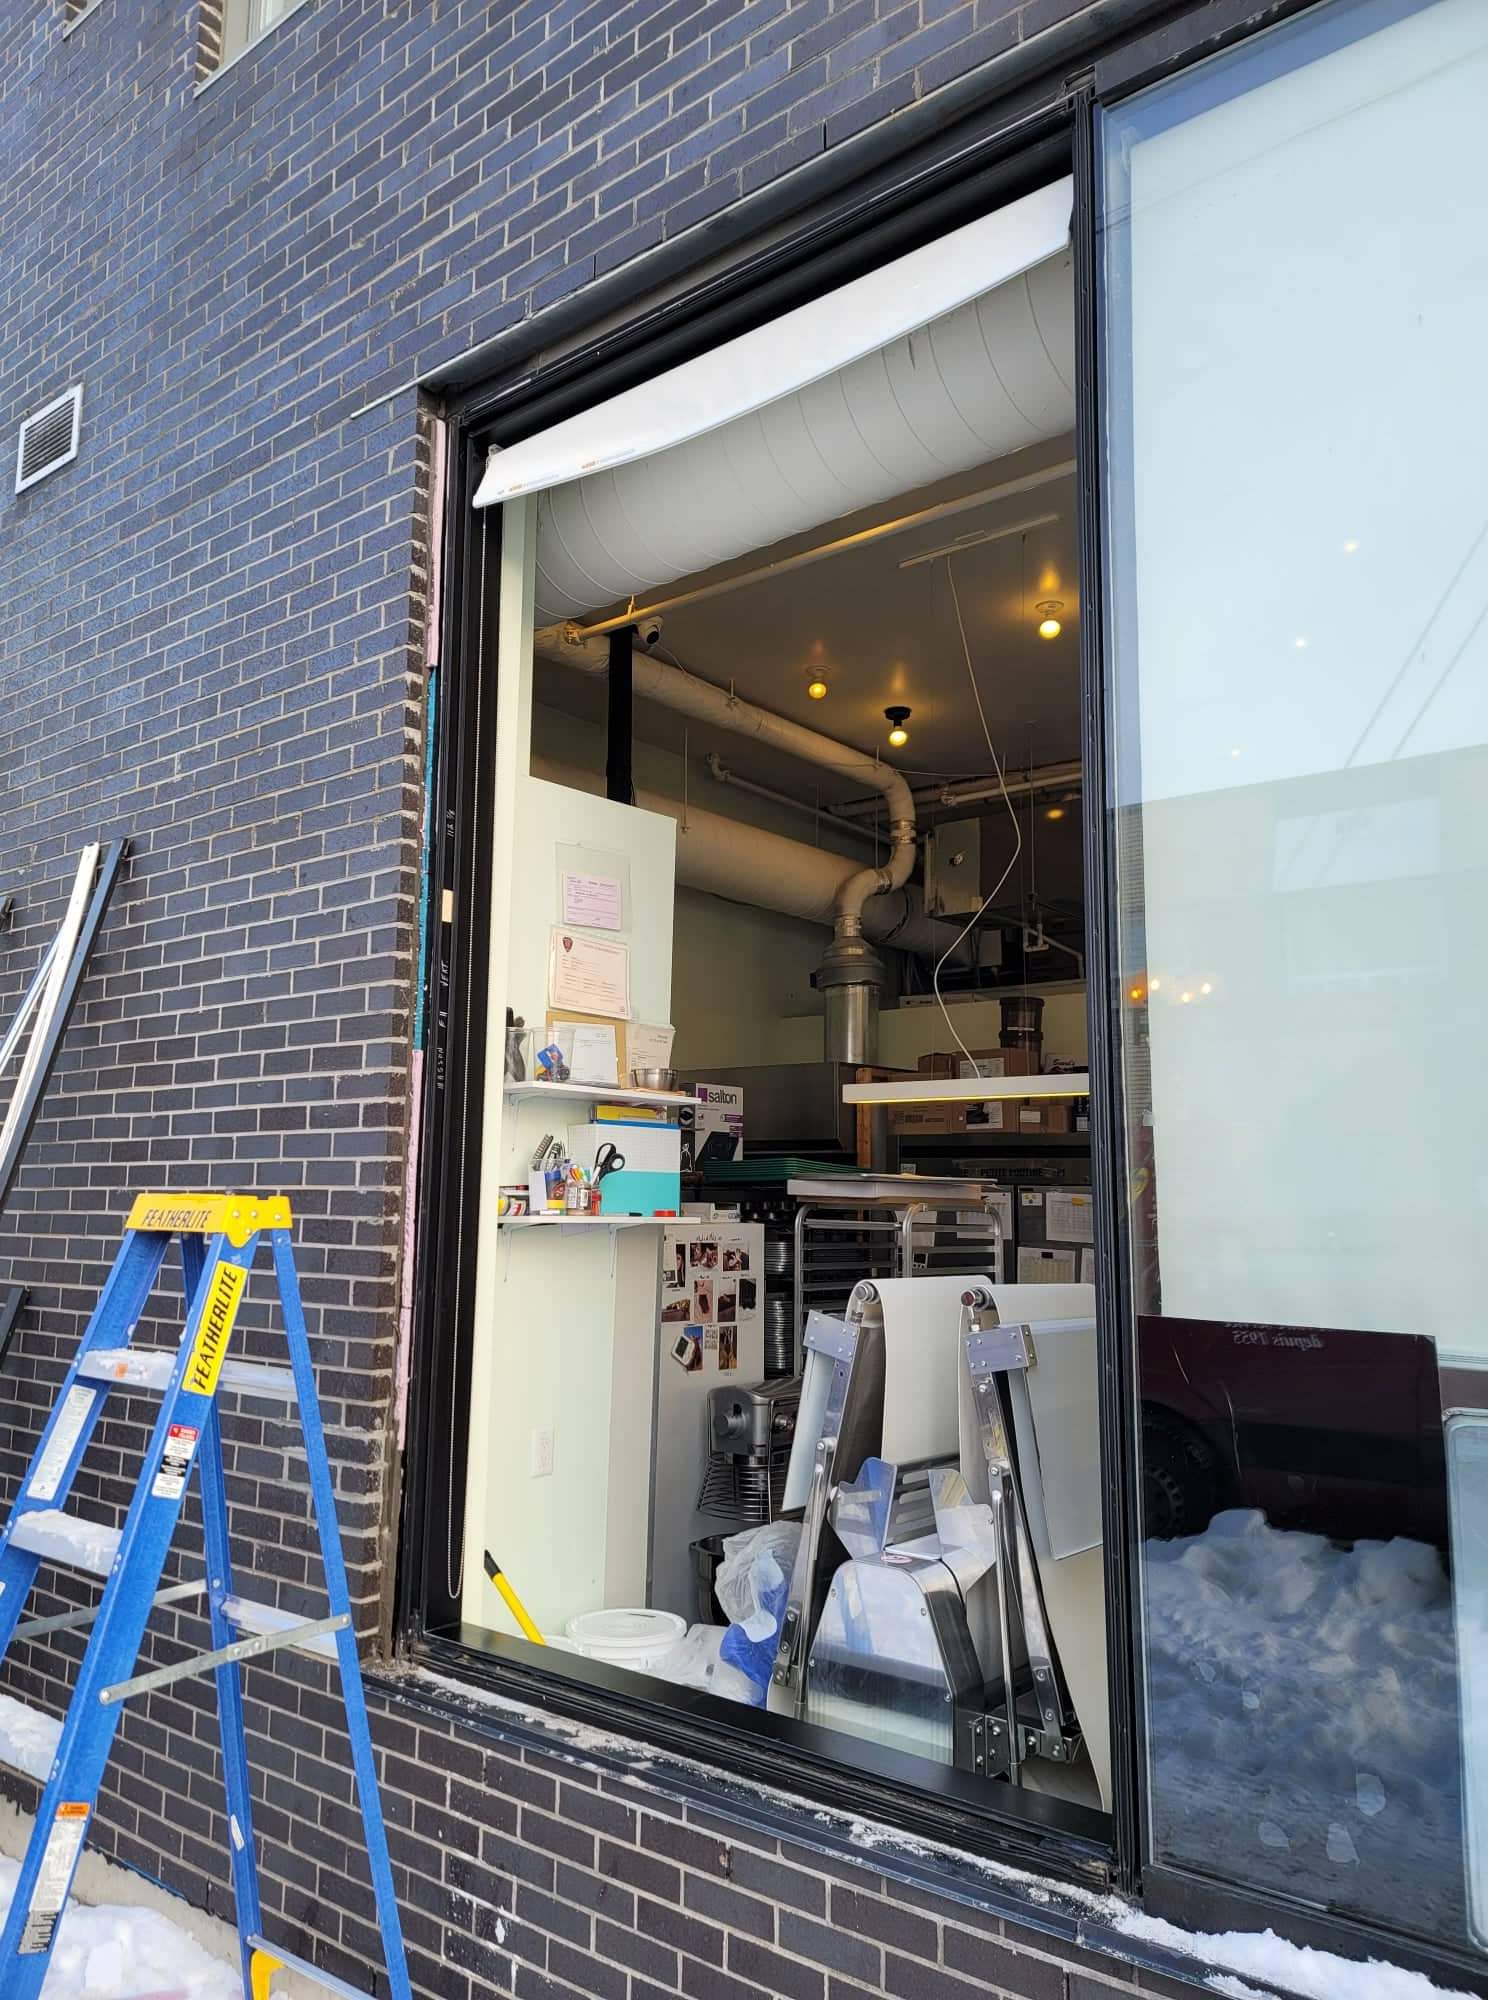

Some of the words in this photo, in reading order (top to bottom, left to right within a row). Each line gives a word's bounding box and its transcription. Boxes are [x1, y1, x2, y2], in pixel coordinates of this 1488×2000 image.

[708, 1089, 737, 1104] salton
[142, 1208, 212, 1228] FEATHERLITE
[191, 1266, 238, 1391] FEATHERLITE
